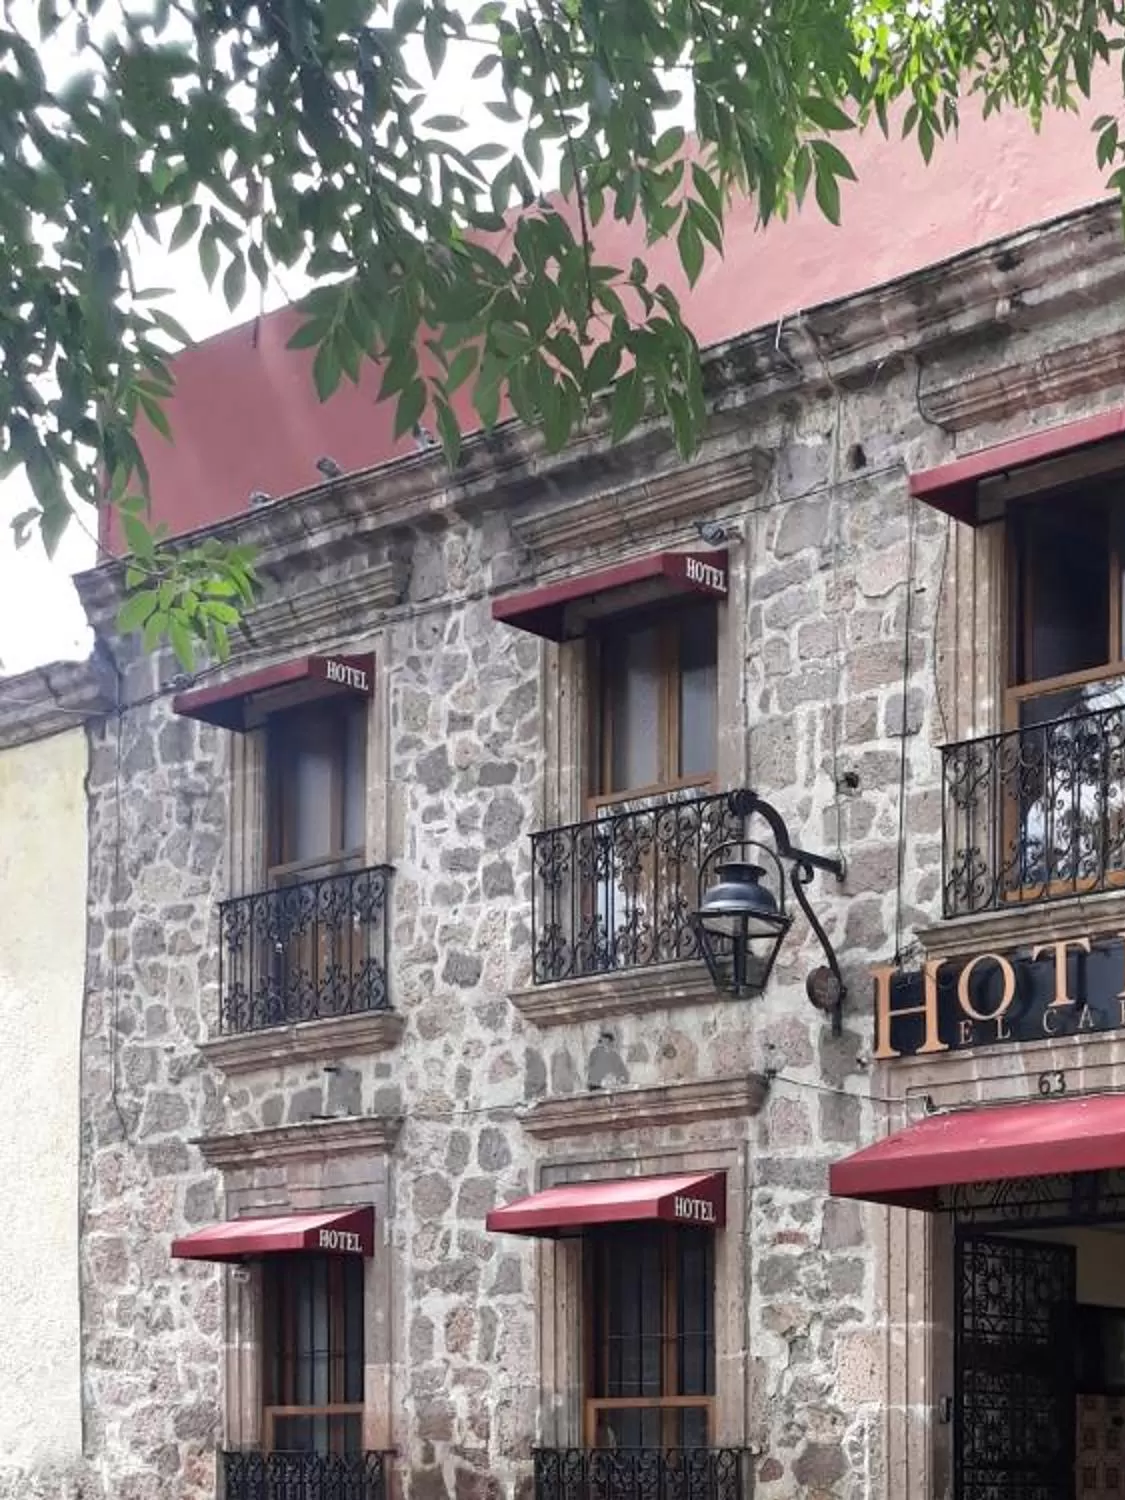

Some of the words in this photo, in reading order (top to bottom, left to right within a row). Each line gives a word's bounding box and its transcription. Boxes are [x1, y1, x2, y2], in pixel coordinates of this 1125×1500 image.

[685, 557, 728, 592] HOTEL
[326, 659, 369, 692] HOTEL
[960, 1018, 1011, 1045] EL
[1038, 1072, 1066, 1095] 63
[674, 1195, 717, 1222] HOTEL
[319, 1228, 363, 1253] HOTEL
